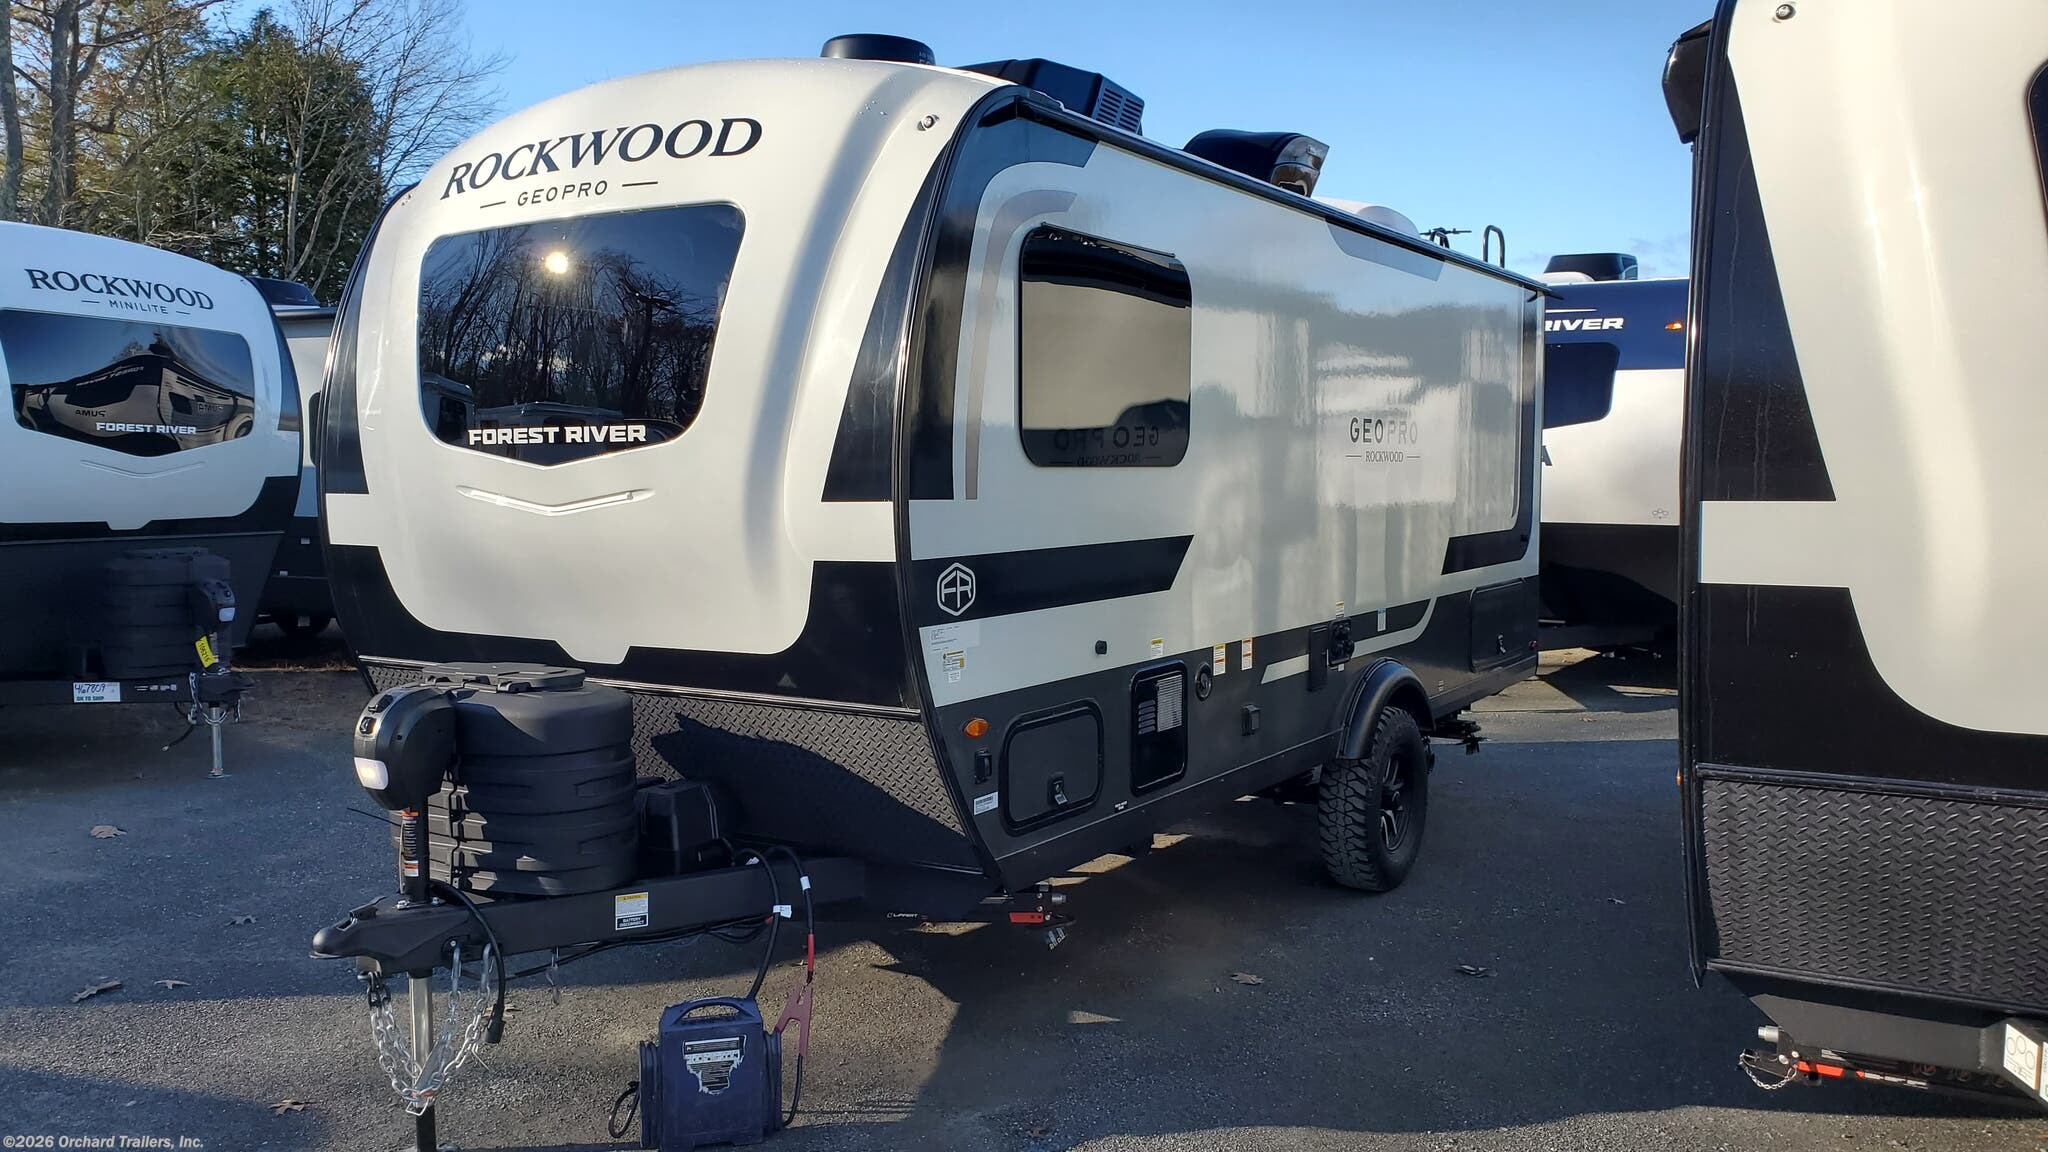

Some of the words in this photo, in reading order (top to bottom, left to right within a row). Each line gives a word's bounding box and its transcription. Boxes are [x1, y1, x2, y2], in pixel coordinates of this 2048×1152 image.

[441, 117, 763, 201] ROCKWOOD
[517, 180, 609, 207] GEOPRO
[24, 268, 215, 310] ROCKWOOD
[109, 299, 169, 314] MINILITE
[96, 422, 153, 433] FOREST
[156, 424, 197, 435] RIVER
[468, 427, 560, 446] FOREST
[565, 424, 647, 443] RIVER
[1365, 451, 1404, 463] ROCKWOOD
